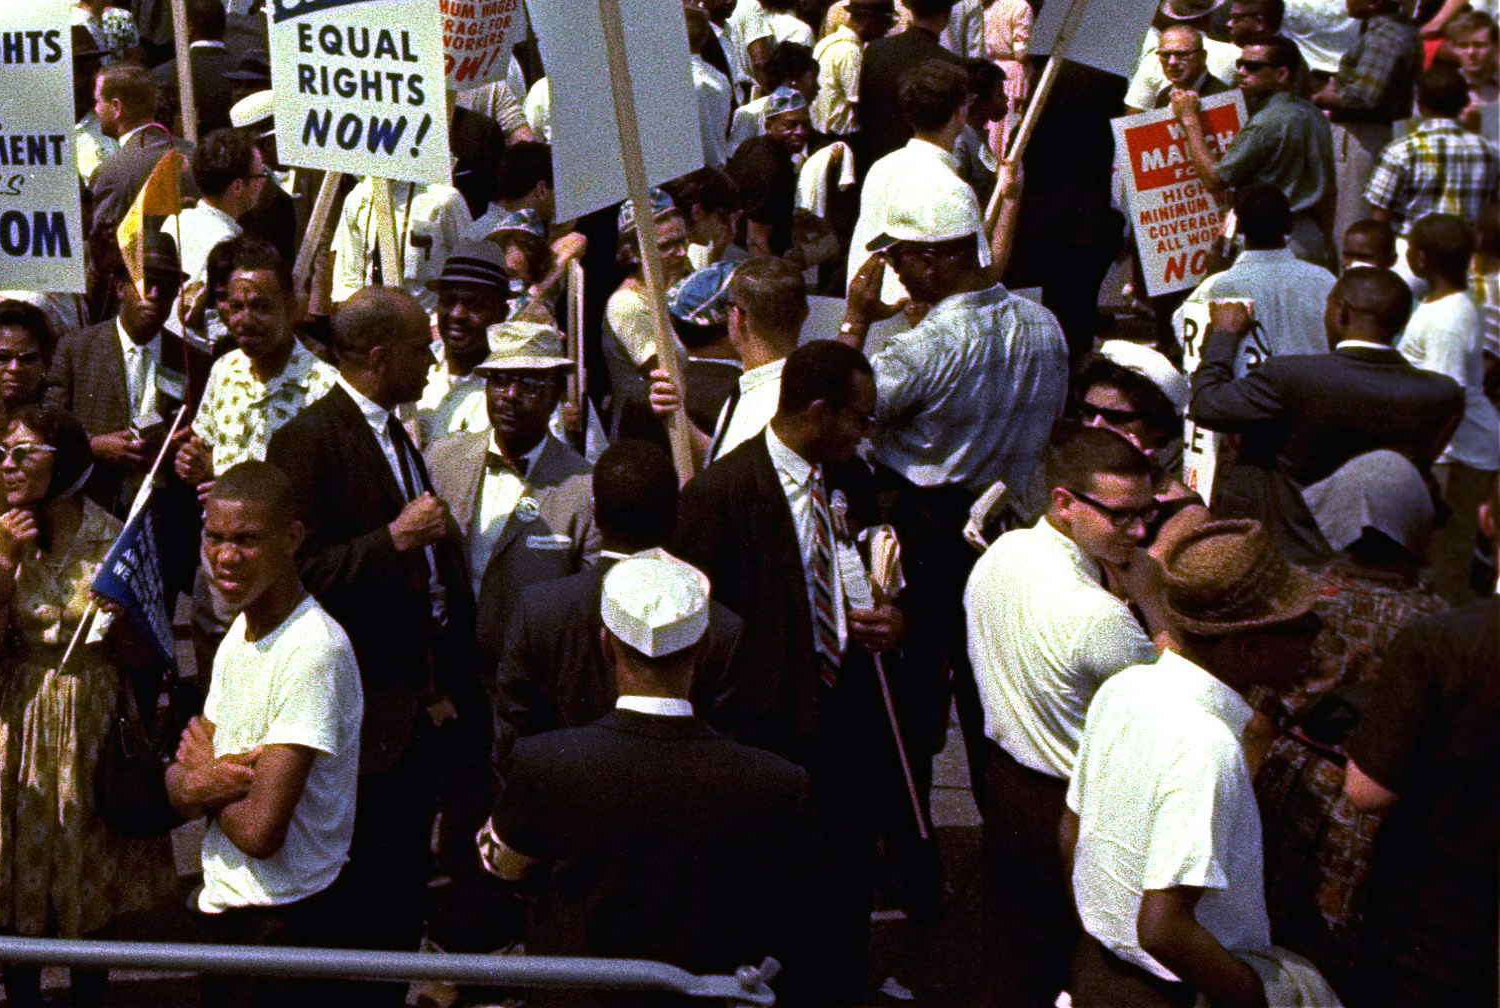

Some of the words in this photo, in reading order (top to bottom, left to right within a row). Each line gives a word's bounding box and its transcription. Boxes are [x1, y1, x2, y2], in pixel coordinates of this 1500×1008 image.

[444, 18, 484, 35] RAGE
[489, 15, 511, 29] FOR
[298, 23, 418, 62] EQUAL
[297, 63, 426, 107] RIGHTS
[301, 108, 432, 158] NOW!
[1167, 122, 1188, 140] W
[1140, 197, 1209, 225] MINIMUM
[1157, 240, 1184, 254] ALL
[1164, 249, 1208, 284] NO
